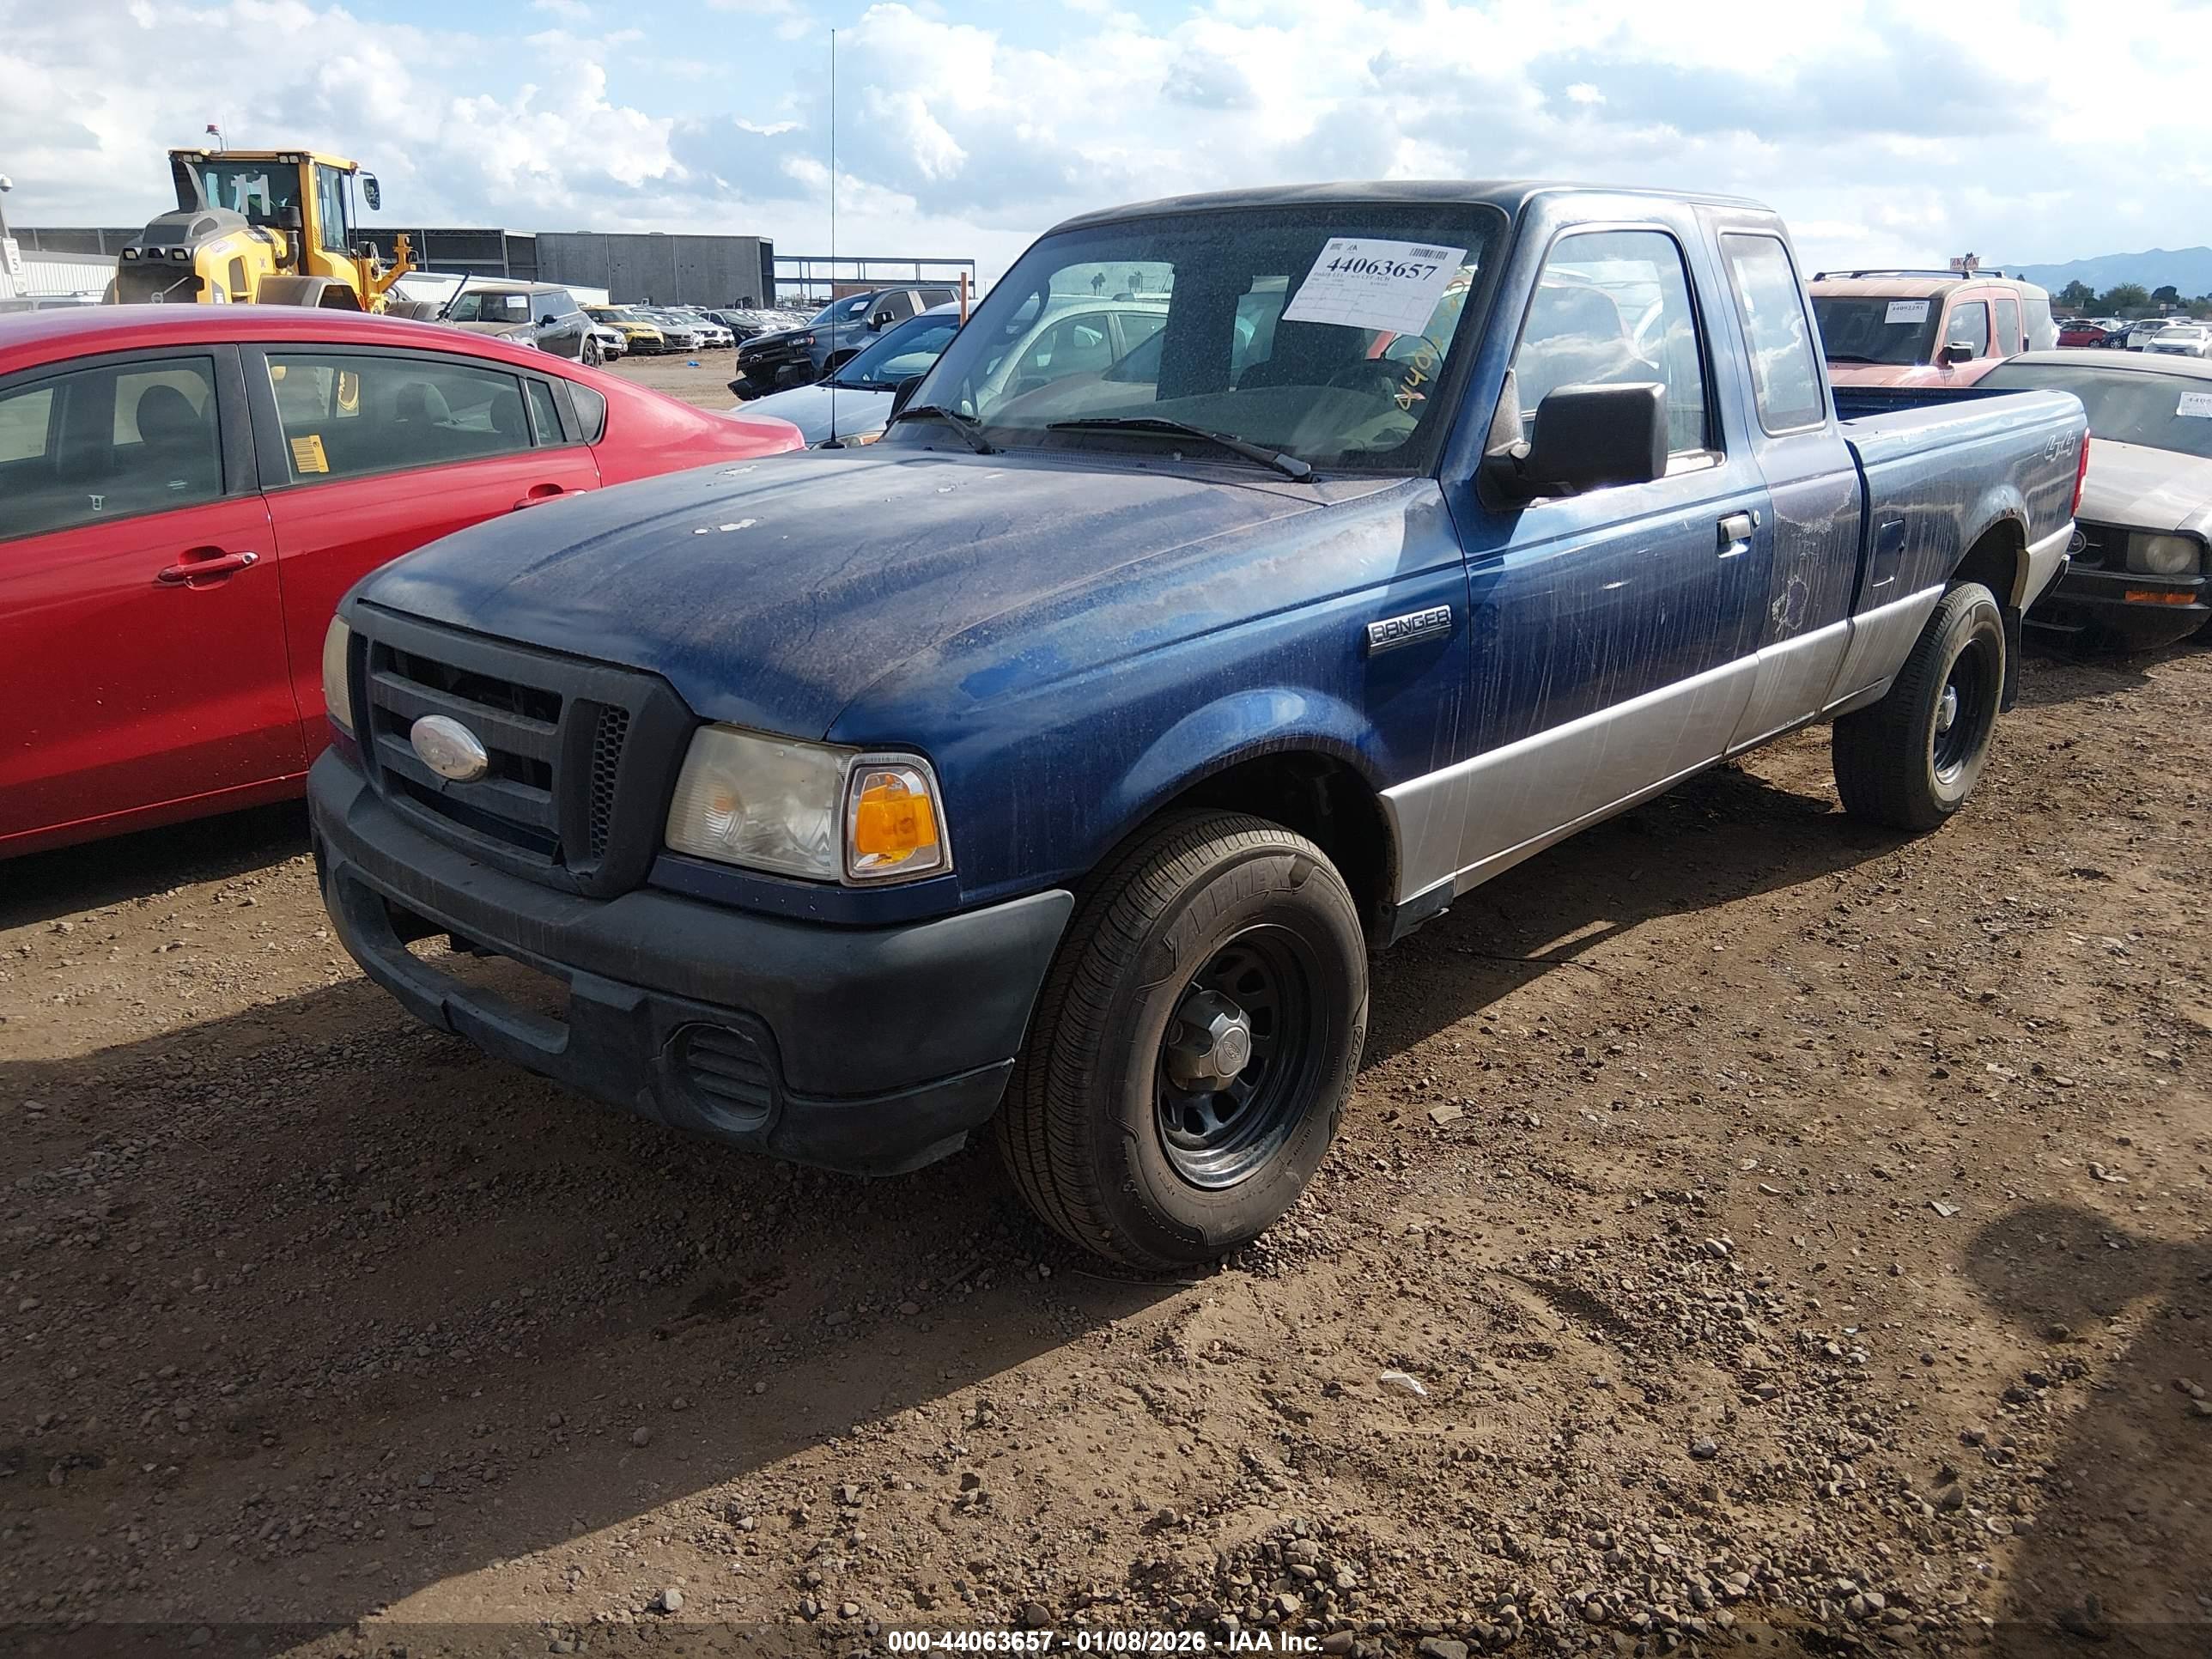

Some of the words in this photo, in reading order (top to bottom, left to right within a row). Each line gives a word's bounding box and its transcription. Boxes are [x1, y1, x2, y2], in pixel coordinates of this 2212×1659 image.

[231, 173, 271, 216] 11
[12, 258, 20, 271] 5
[1327, 256, 1439, 282] 44063657
[2044, 429, 2076, 462] 4x4
[1370, 608, 1449, 642] RANGER
